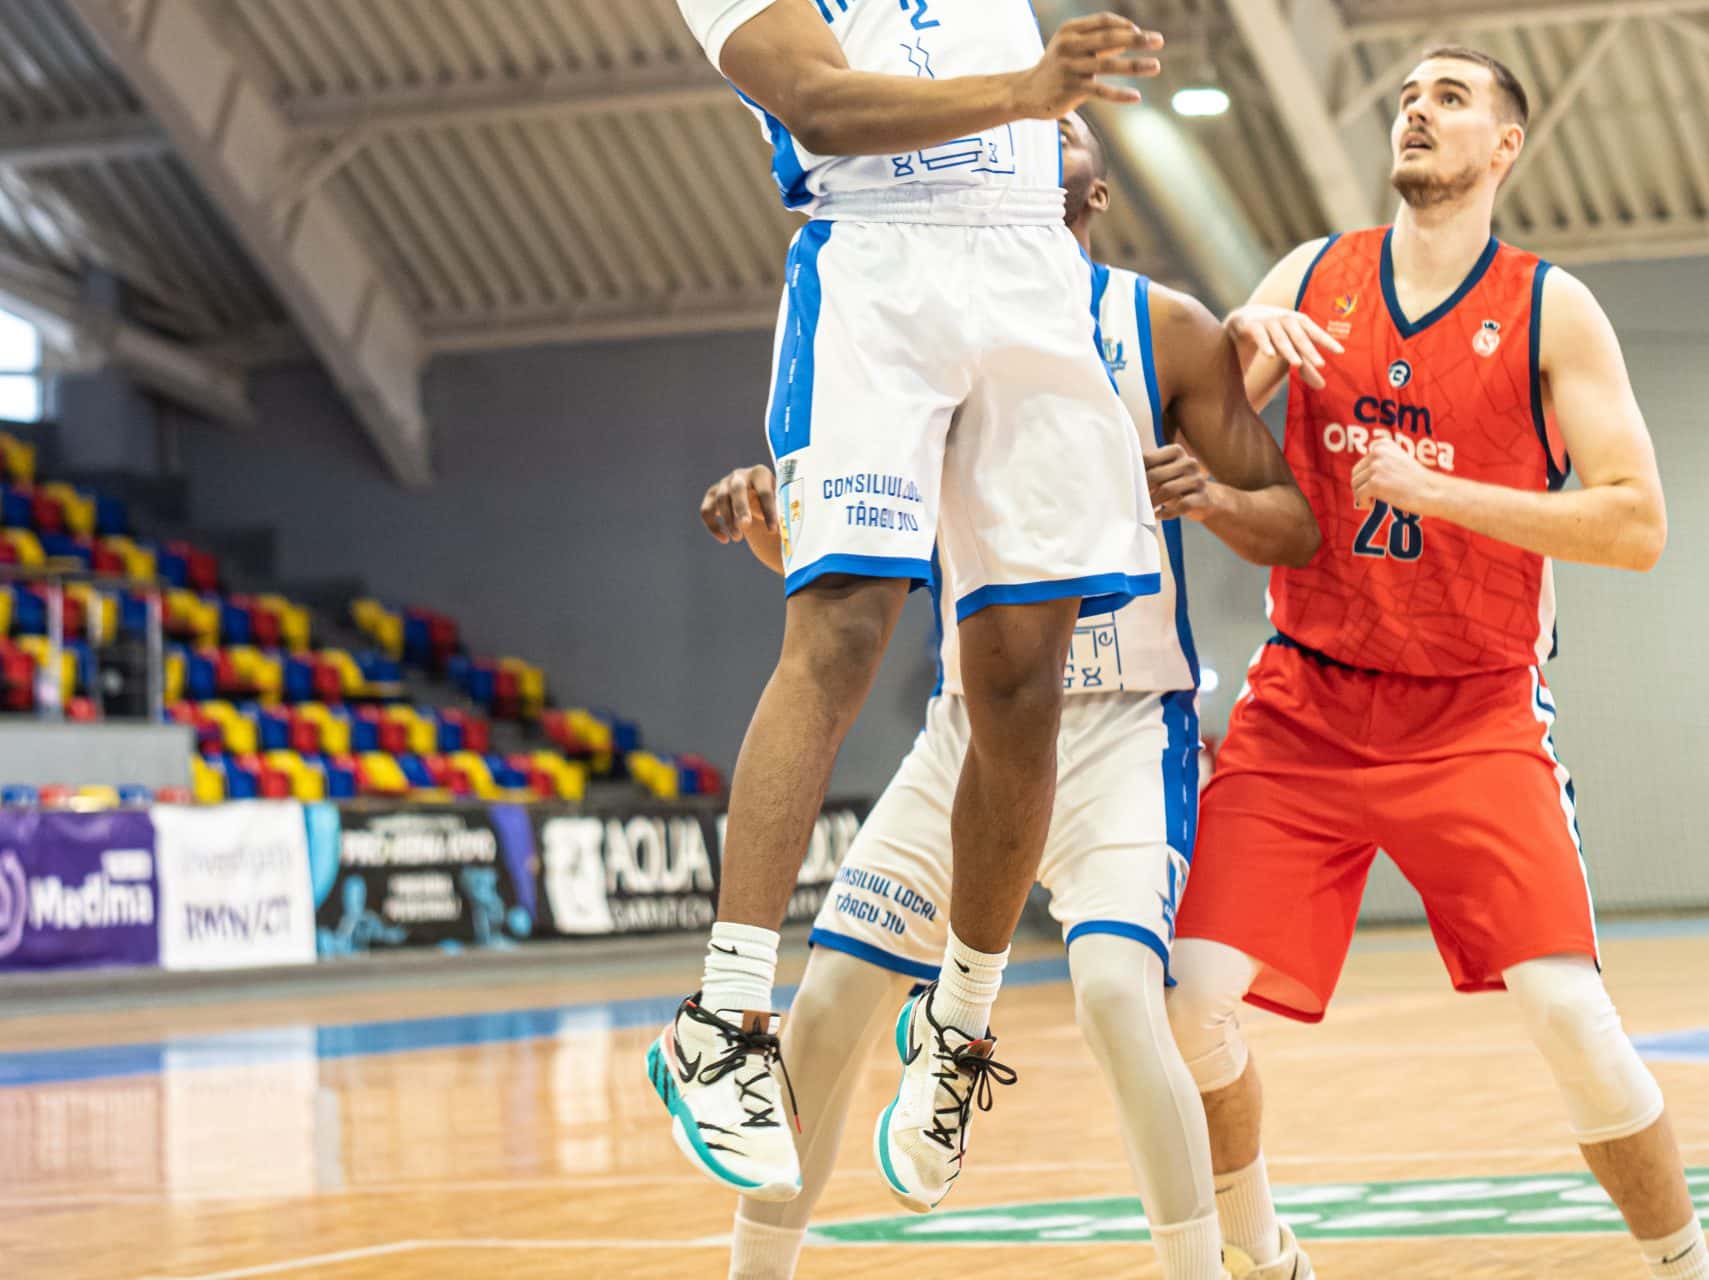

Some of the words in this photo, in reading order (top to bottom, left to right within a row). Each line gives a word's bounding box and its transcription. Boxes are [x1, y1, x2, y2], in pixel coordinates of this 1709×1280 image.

[845, 500, 896, 530] TÂRGU
[897, 511, 919, 532] JIU
[604, 814, 714, 894] AQUA
[836, 892, 881, 924] TÂRGU
[880, 909, 906, 936] JIU
[893, 884, 938, 923] LOCAL
